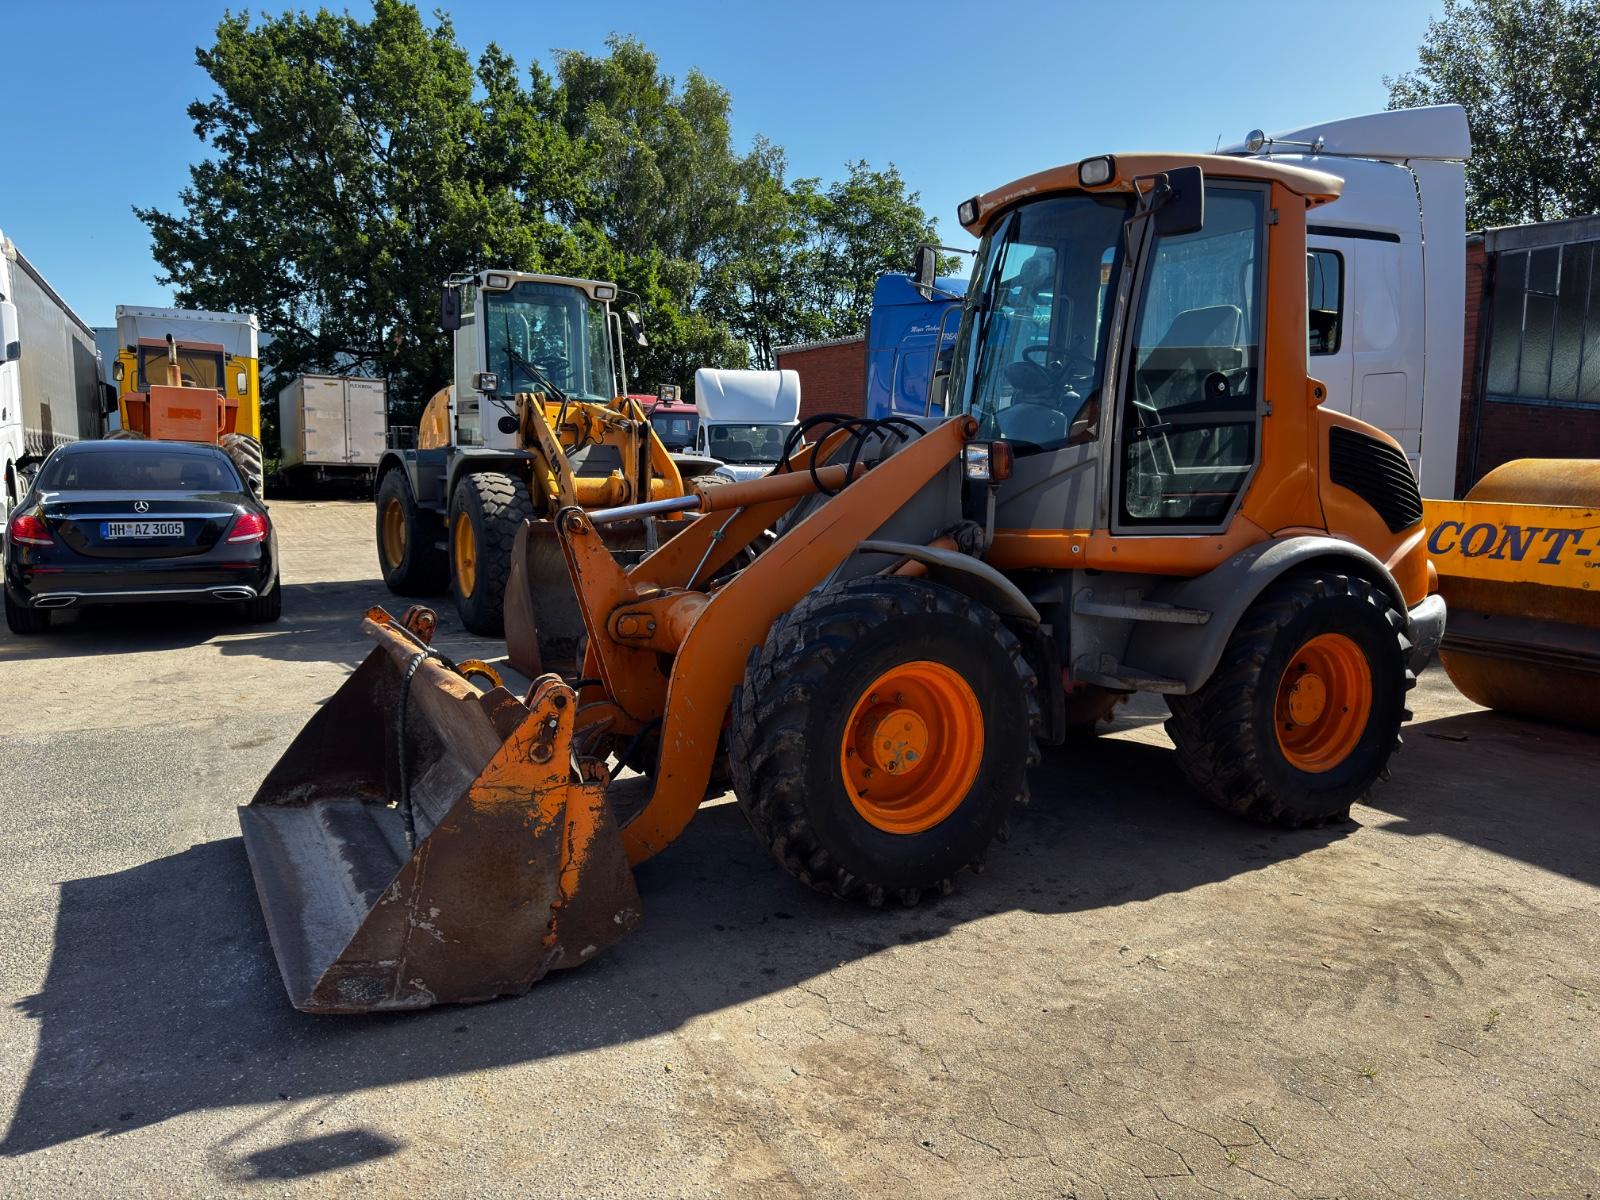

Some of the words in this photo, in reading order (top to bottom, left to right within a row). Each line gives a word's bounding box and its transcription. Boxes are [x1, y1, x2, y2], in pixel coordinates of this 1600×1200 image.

[109, 523, 125, 536] HH
[134, 523, 150, 535] AZ
[152, 523, 182, 535] 3005
[1427, 520, 1600, 565] CONT-
